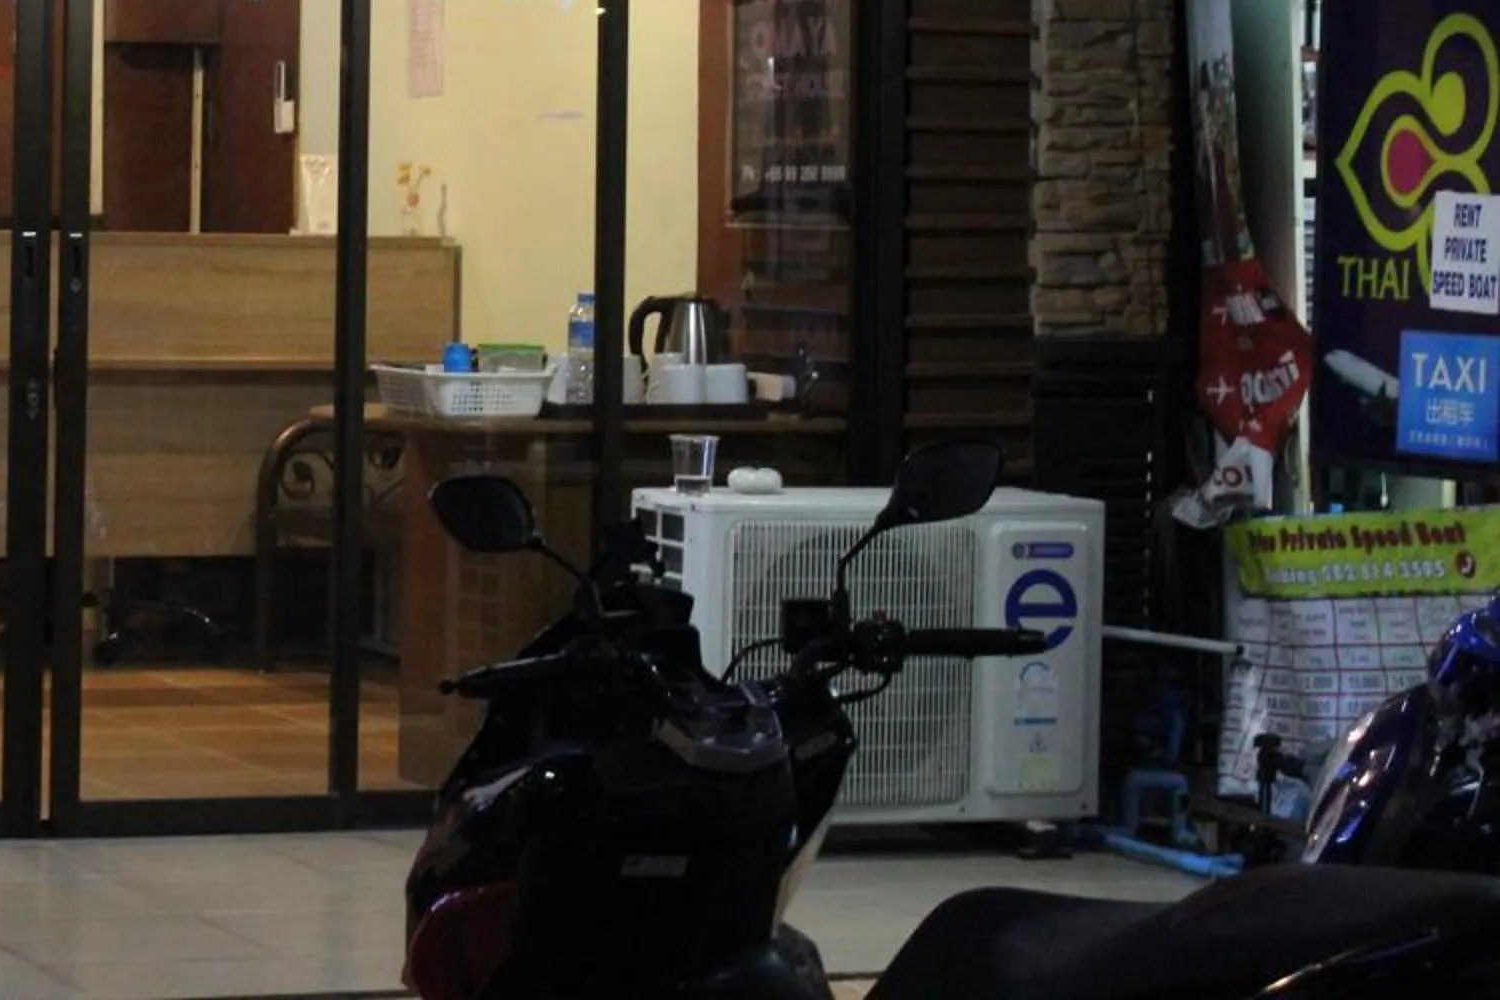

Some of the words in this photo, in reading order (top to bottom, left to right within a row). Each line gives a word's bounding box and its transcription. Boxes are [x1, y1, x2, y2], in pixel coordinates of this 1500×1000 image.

[1453, 203, 1482, 229] RENT
[1444, 237, 1488, 263] PRIVATE
[1338, 256, 1411, 300] THAI
[1431, 268, 1464, 299] SPEED
[1468, 272, 1498, 300] BOAT
[1411, 353, 1488, 394] TAXI
